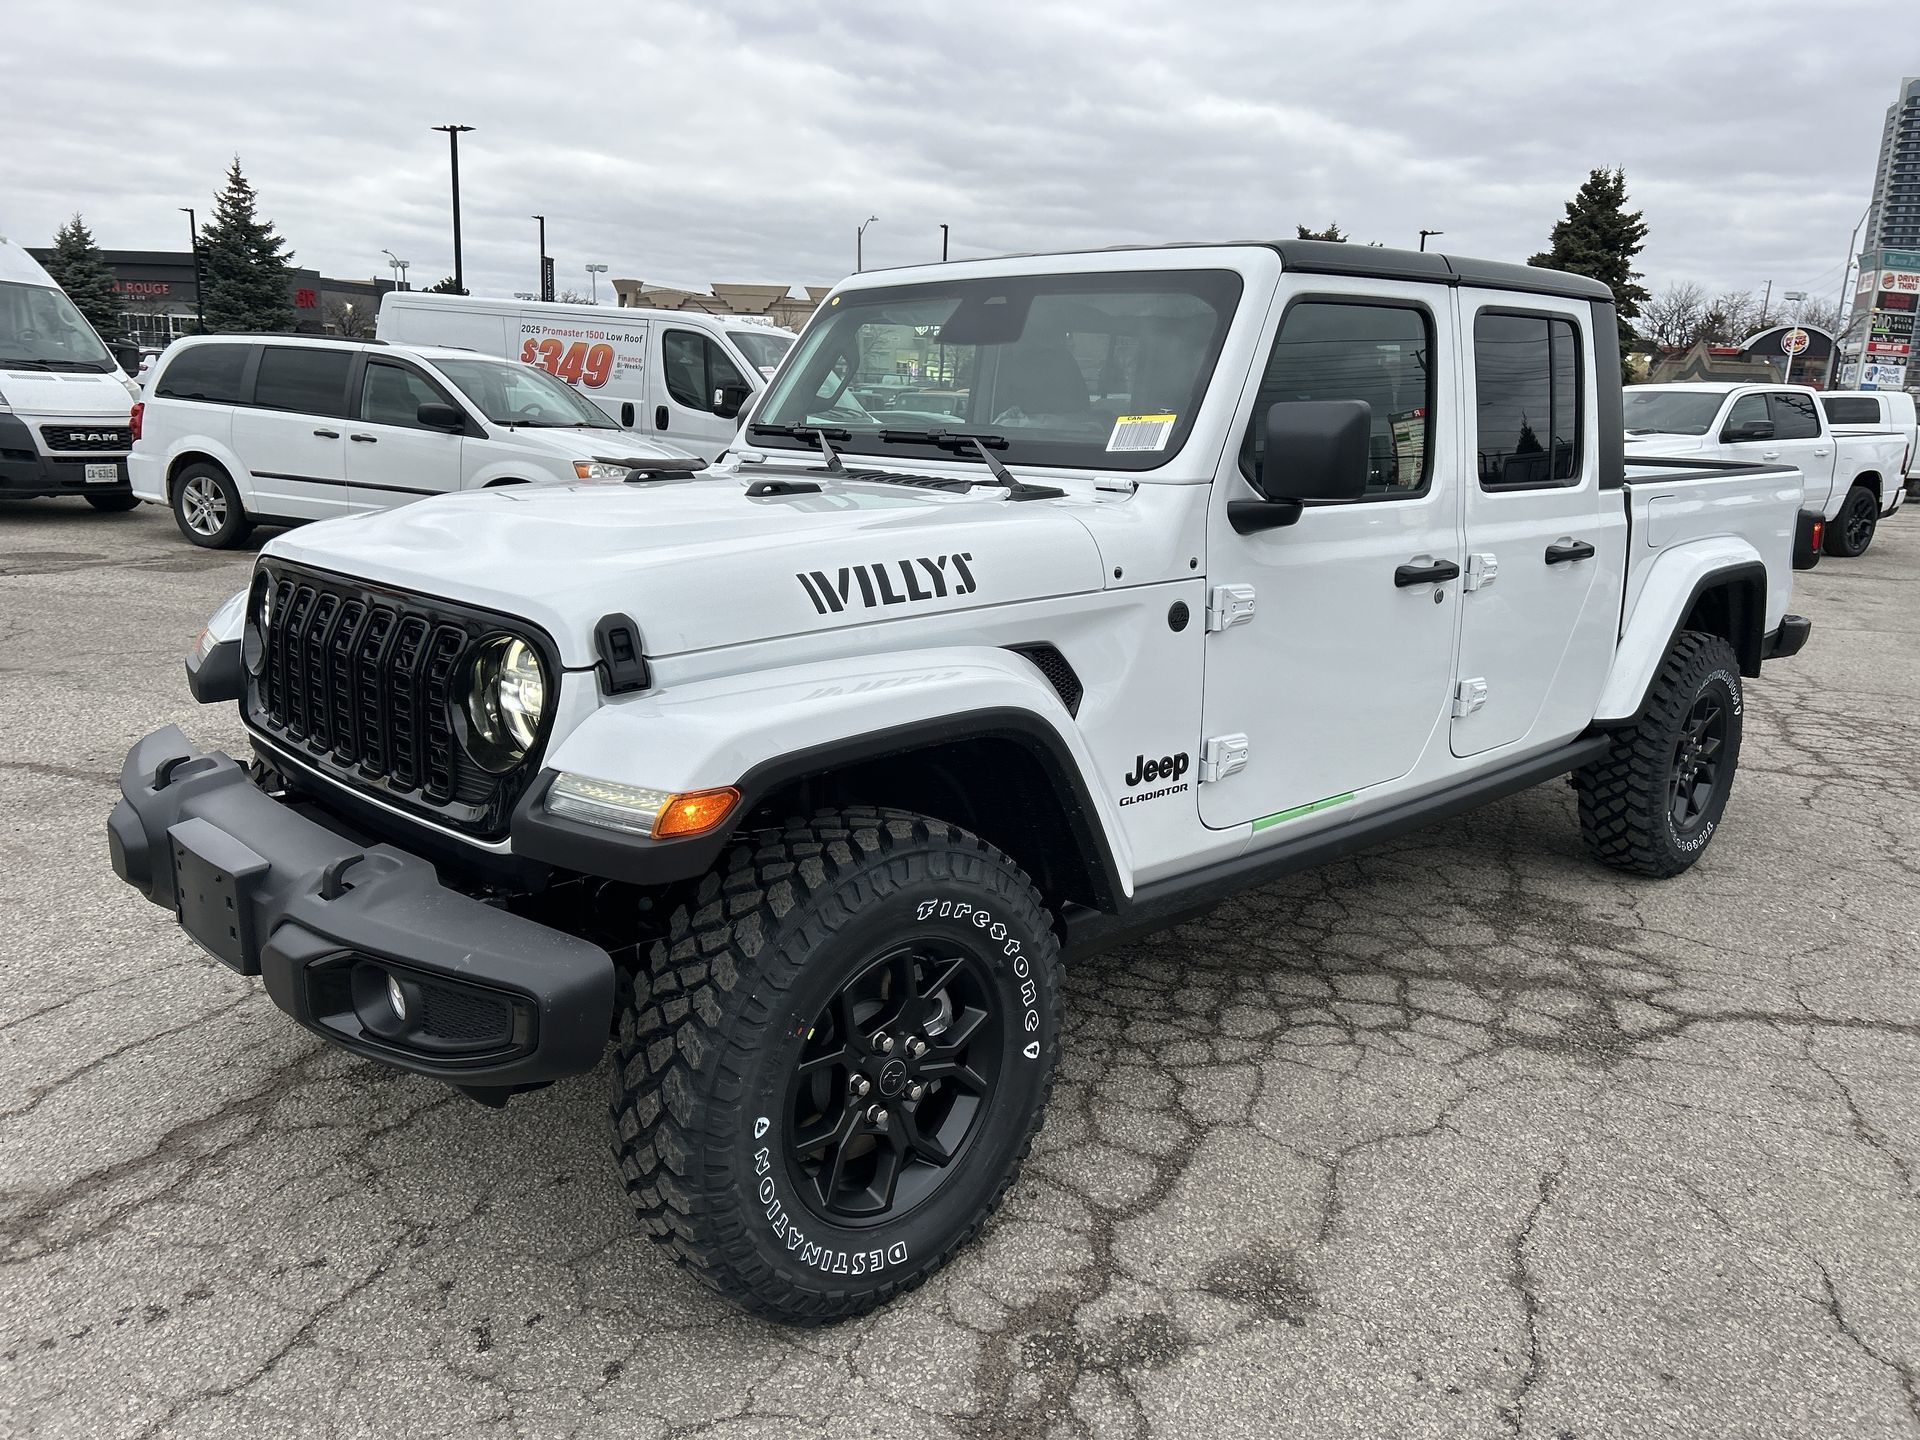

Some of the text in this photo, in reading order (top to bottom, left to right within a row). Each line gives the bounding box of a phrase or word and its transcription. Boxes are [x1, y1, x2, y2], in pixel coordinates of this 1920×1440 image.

[1897, 274, 1920, 284] DRIVE
[1898, 282, 1918, 291] THRU
[125, 282, 170, 295] ROUGE
[521, 324, 644, 343] 2025 Promaster 1500 Low Roof
[1785, 340, 1806, 348] KNG
[520, 337, 615, 389] $349
[616, 361, 643, 371] Bi-Weekly
[618, 354, 643, 364] Finance
[69, 433, 118, 441] RAM
[795, 552, 977, 615] WILLYS
[1125, 751, 1190, 787] Jeep
[1119, 783, 1189, 807] GLADIATOR
[916, 898, 1040, 1032] Firestone
[753, 1146, 909, 1275] DESTINATION
